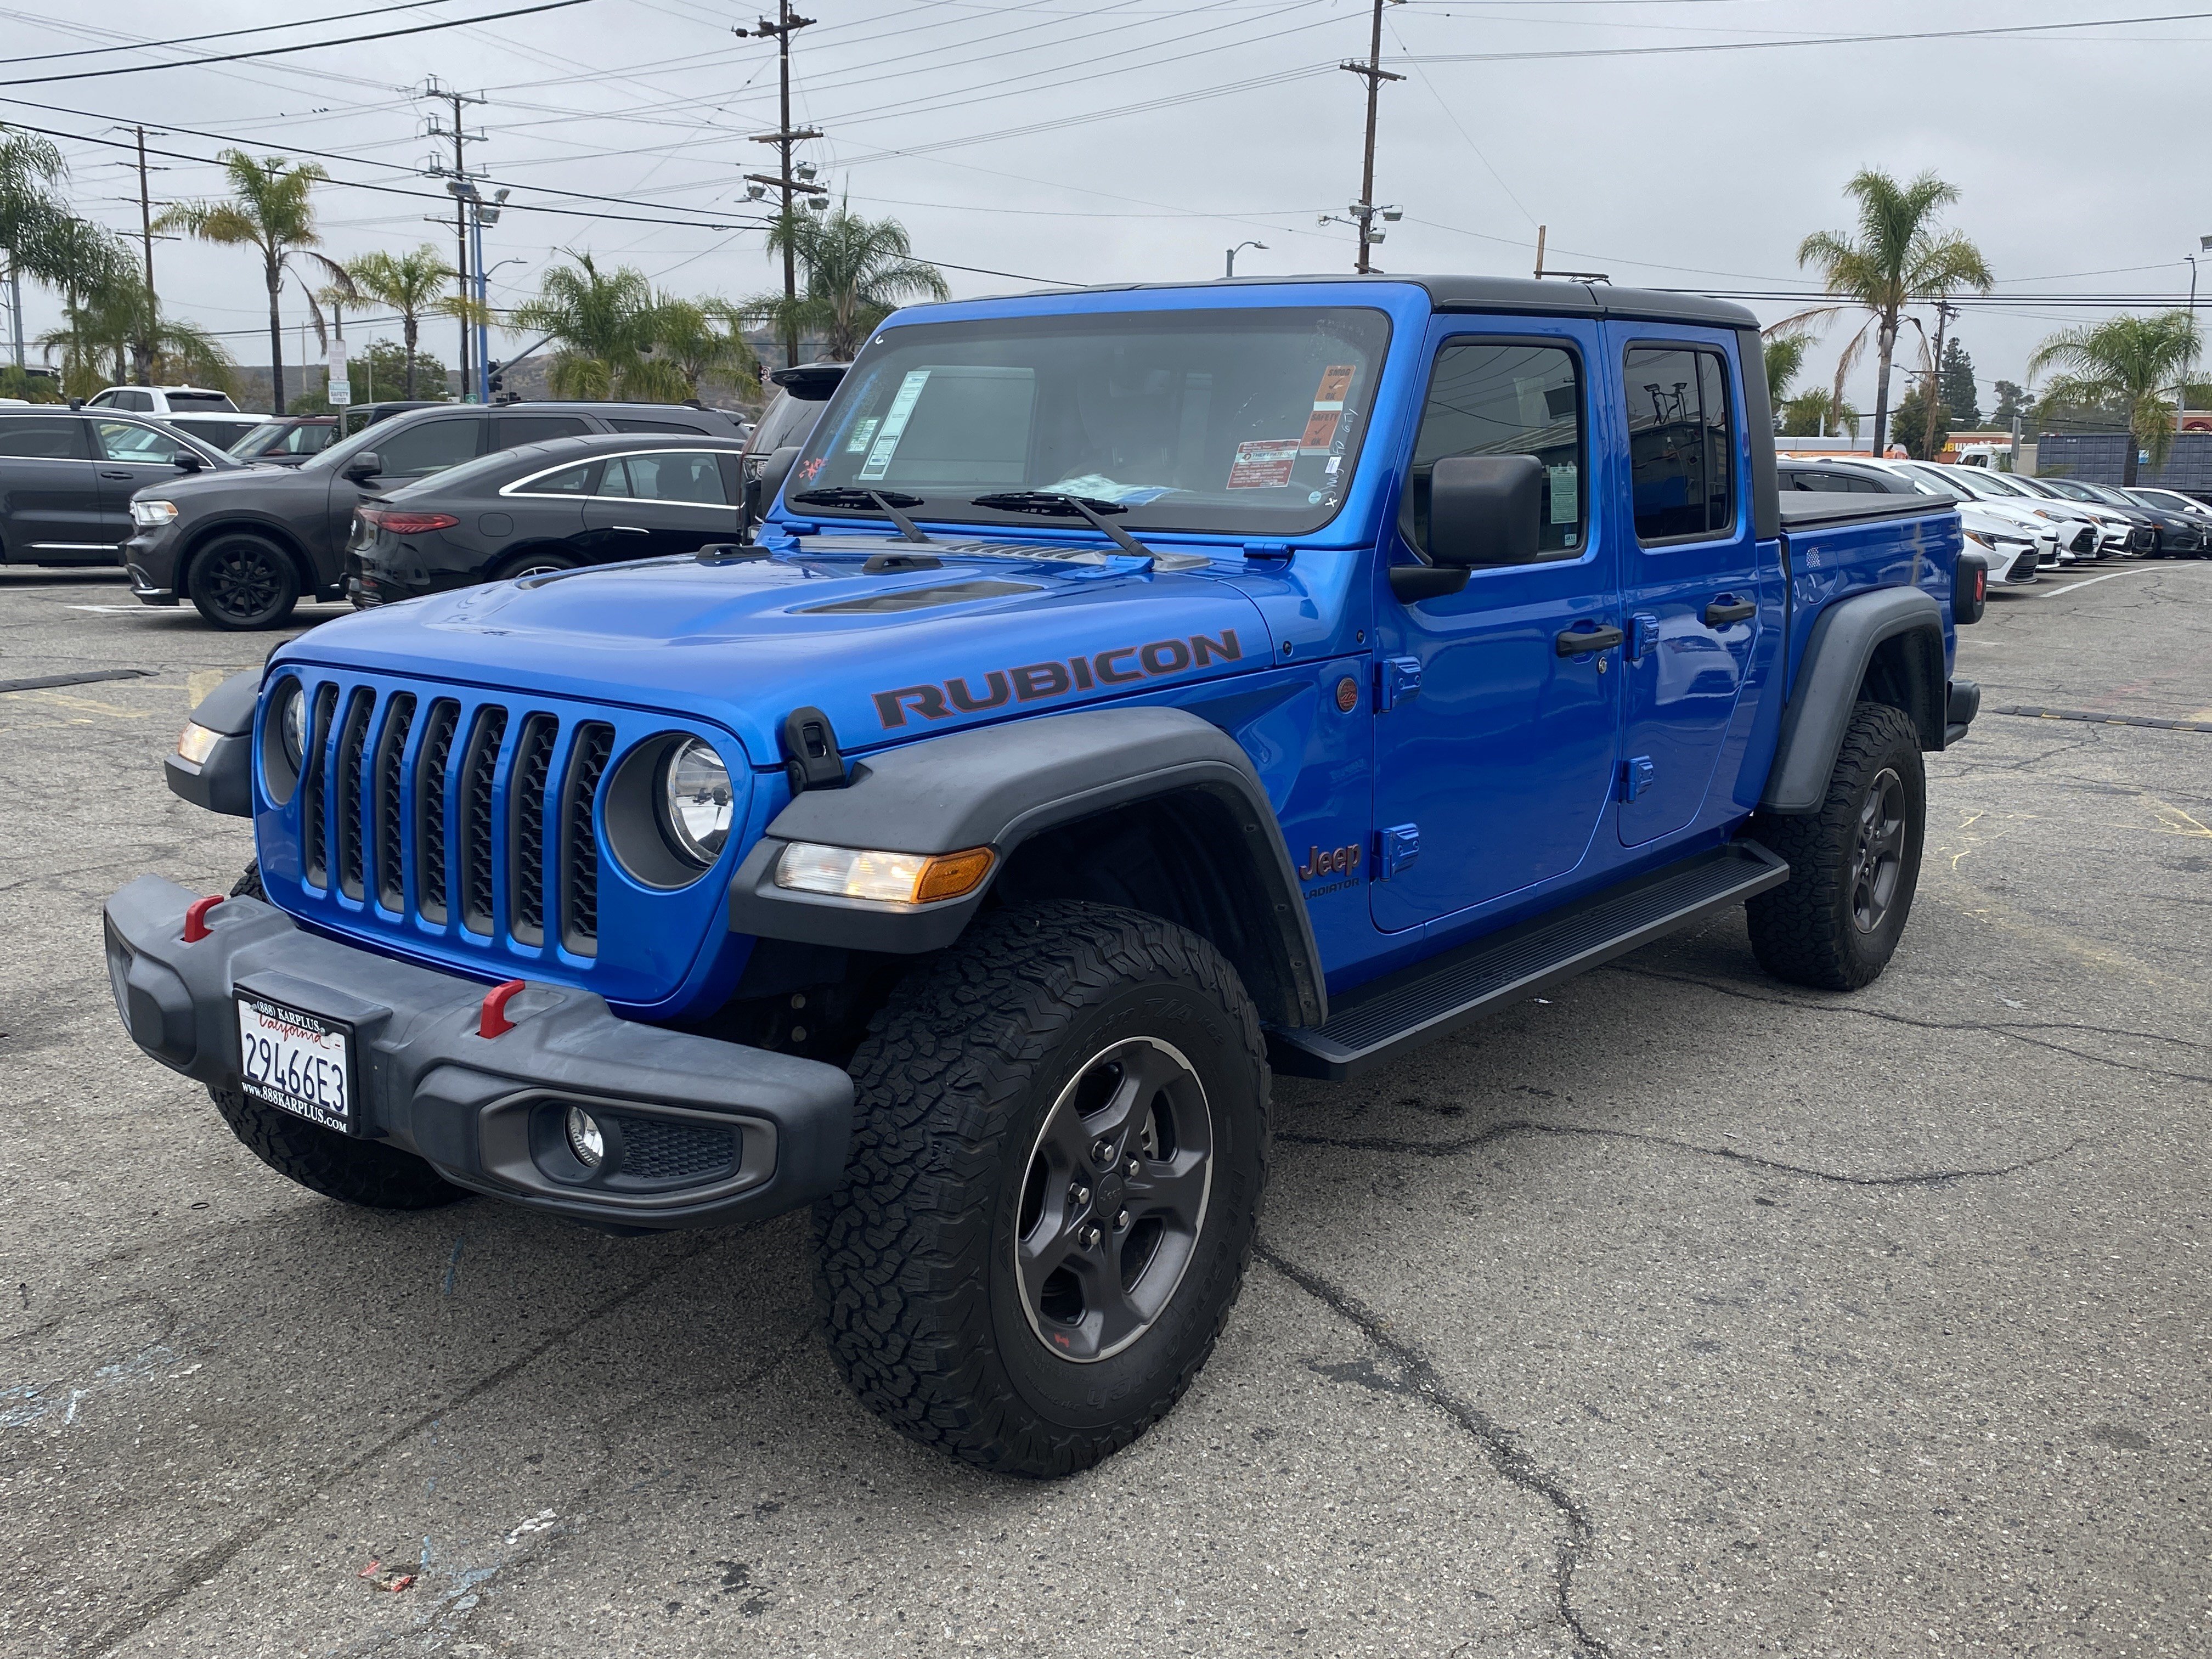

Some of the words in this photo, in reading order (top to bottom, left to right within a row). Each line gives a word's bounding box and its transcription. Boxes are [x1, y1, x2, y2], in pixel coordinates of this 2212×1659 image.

[1328, 368, 1351, 376] SMOG
[1311, 413, 1339, 421] SAFETY
[871, 629, 1242, 730] RUBICON
[1299, 844, 1360, 880] Jeep
[1303, 878, 1360, 900] LADIATOR
[257, 1001, 276, 1016] (888)
[277, 1008, 319, 1031] KARPLUS
[259, 1014, 330, 1049] California
[246, 1032, 345, 1112] 29466E3
